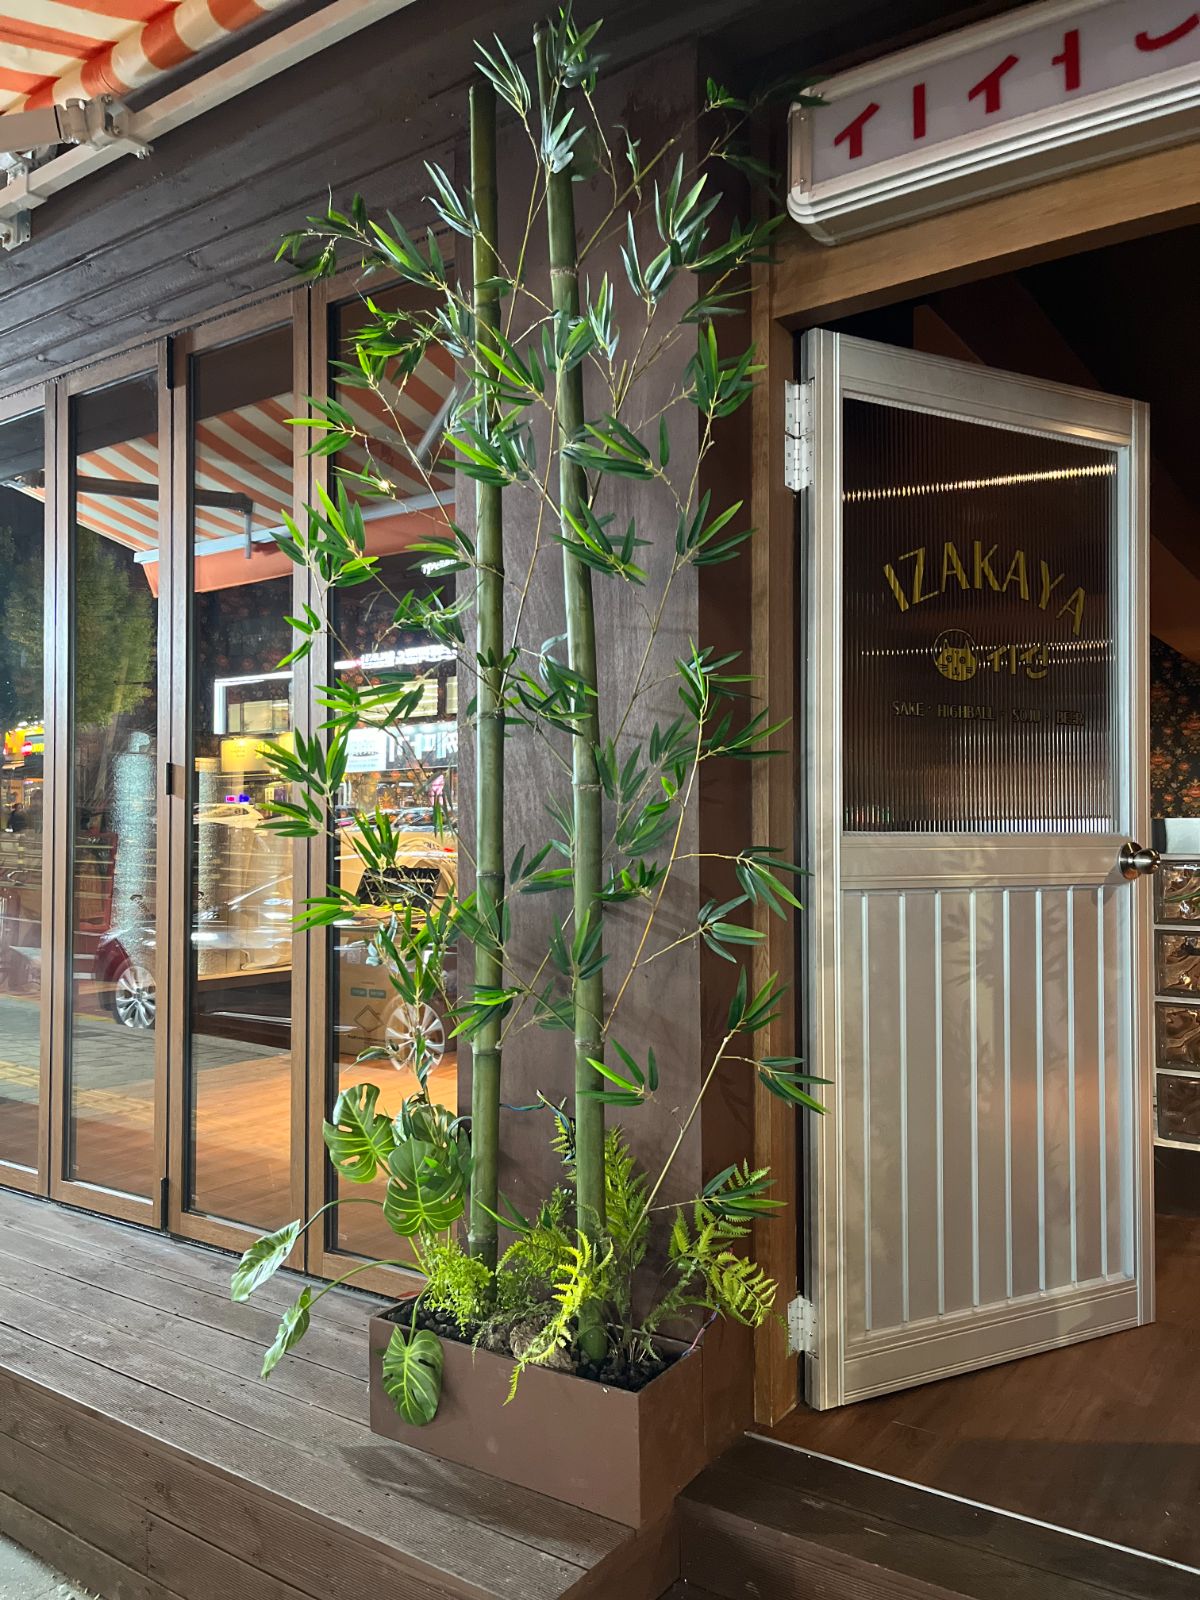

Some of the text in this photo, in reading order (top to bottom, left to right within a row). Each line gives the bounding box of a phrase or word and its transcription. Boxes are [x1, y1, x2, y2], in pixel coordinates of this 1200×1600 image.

[883, 540, 1086, 636] IZAKAYA
[891, 701, 1086, 726] SAKE HIGHBALL SOJU BEER
